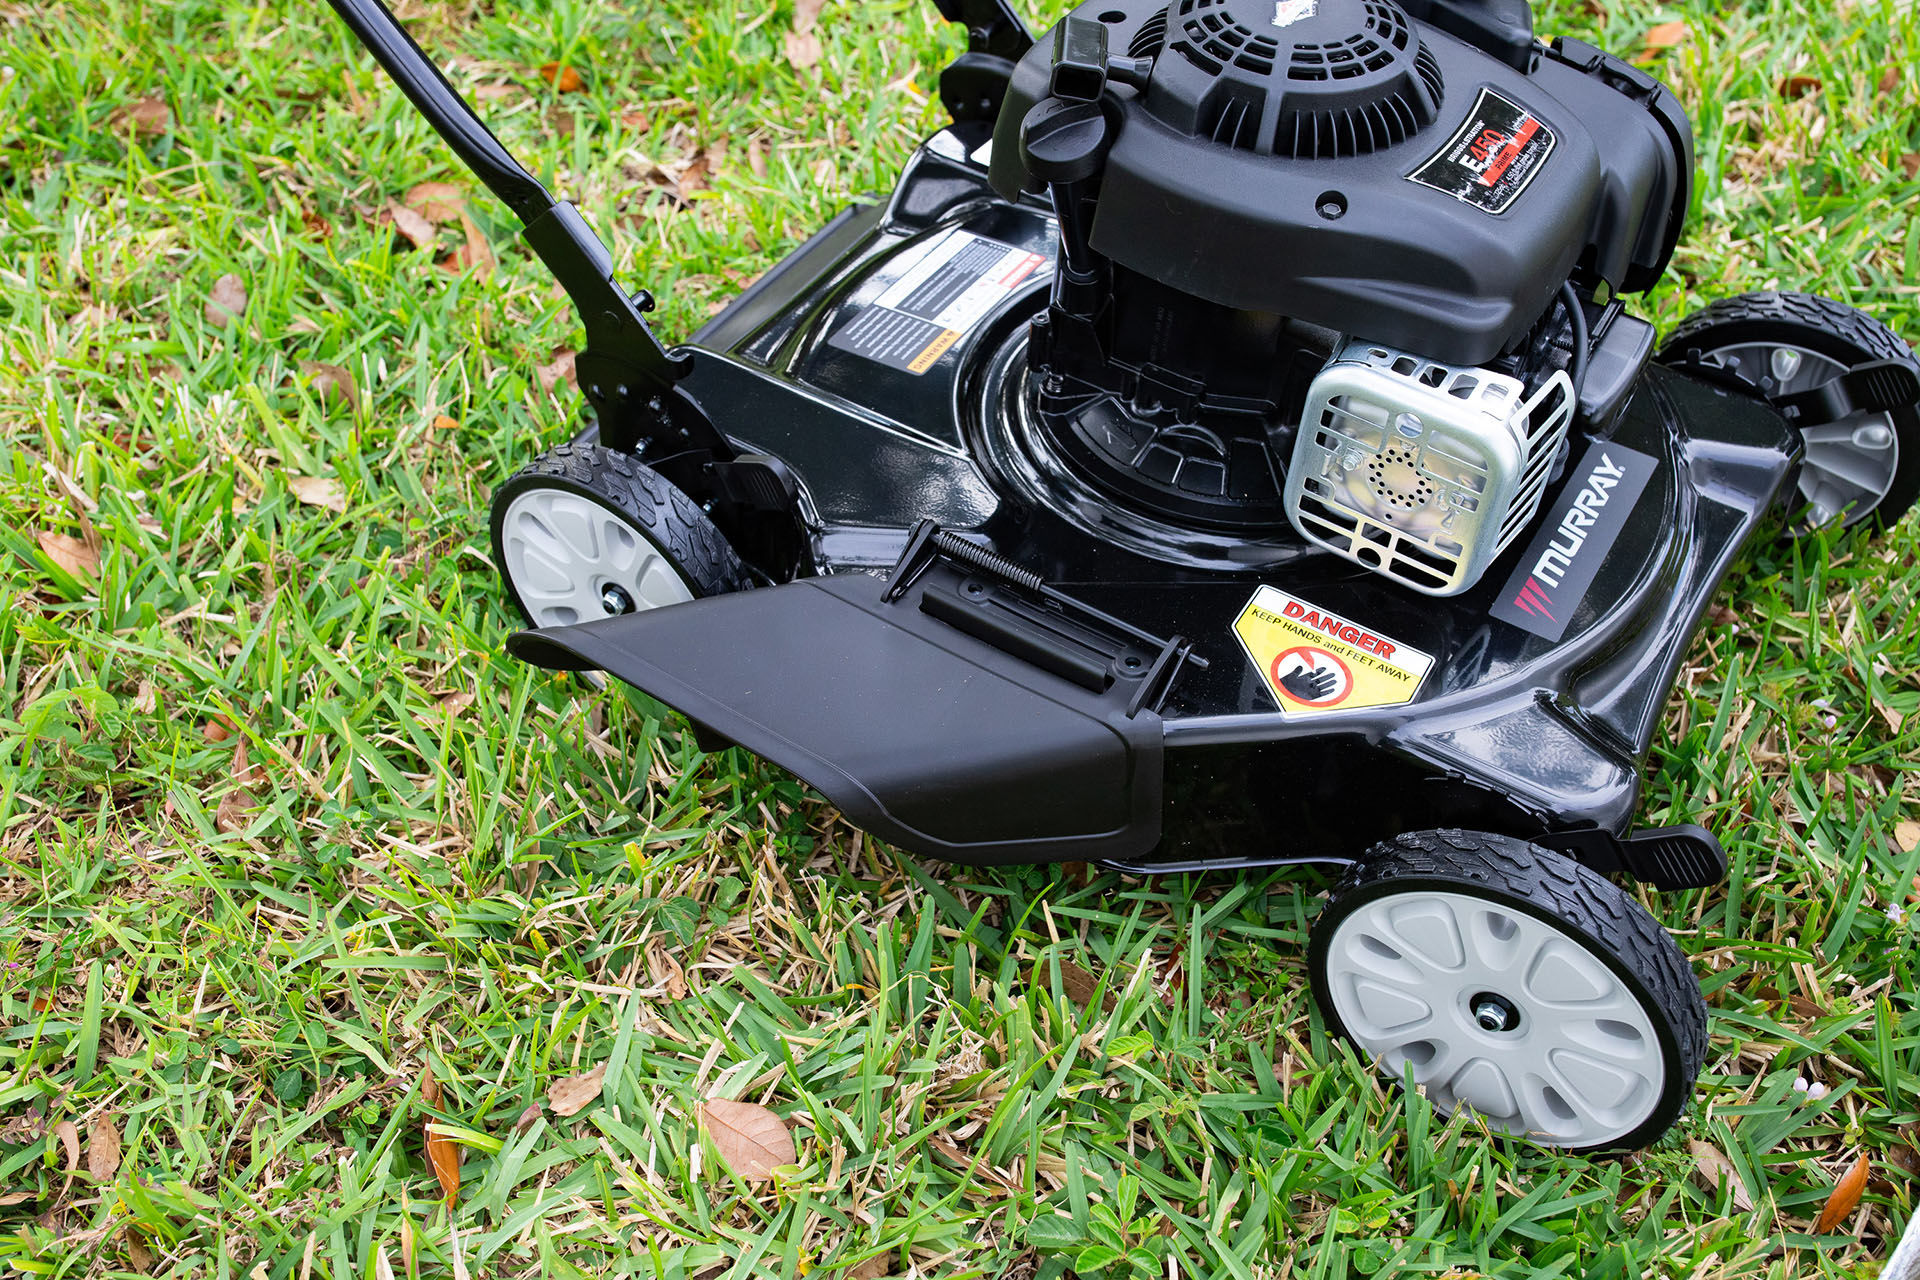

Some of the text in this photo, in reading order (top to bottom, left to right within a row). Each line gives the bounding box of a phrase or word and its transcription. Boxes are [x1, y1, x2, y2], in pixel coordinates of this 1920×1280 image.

[1495, 151, 1513, 170] PRIME
[913, 337, 949, 370] WARNING
[1531, 452, 1625, 589] MURRAY
[1251, 608, 1411, 682] KEEP HANDS and FEET AWAY
[1282, 600, 1397, 660] DANGER
